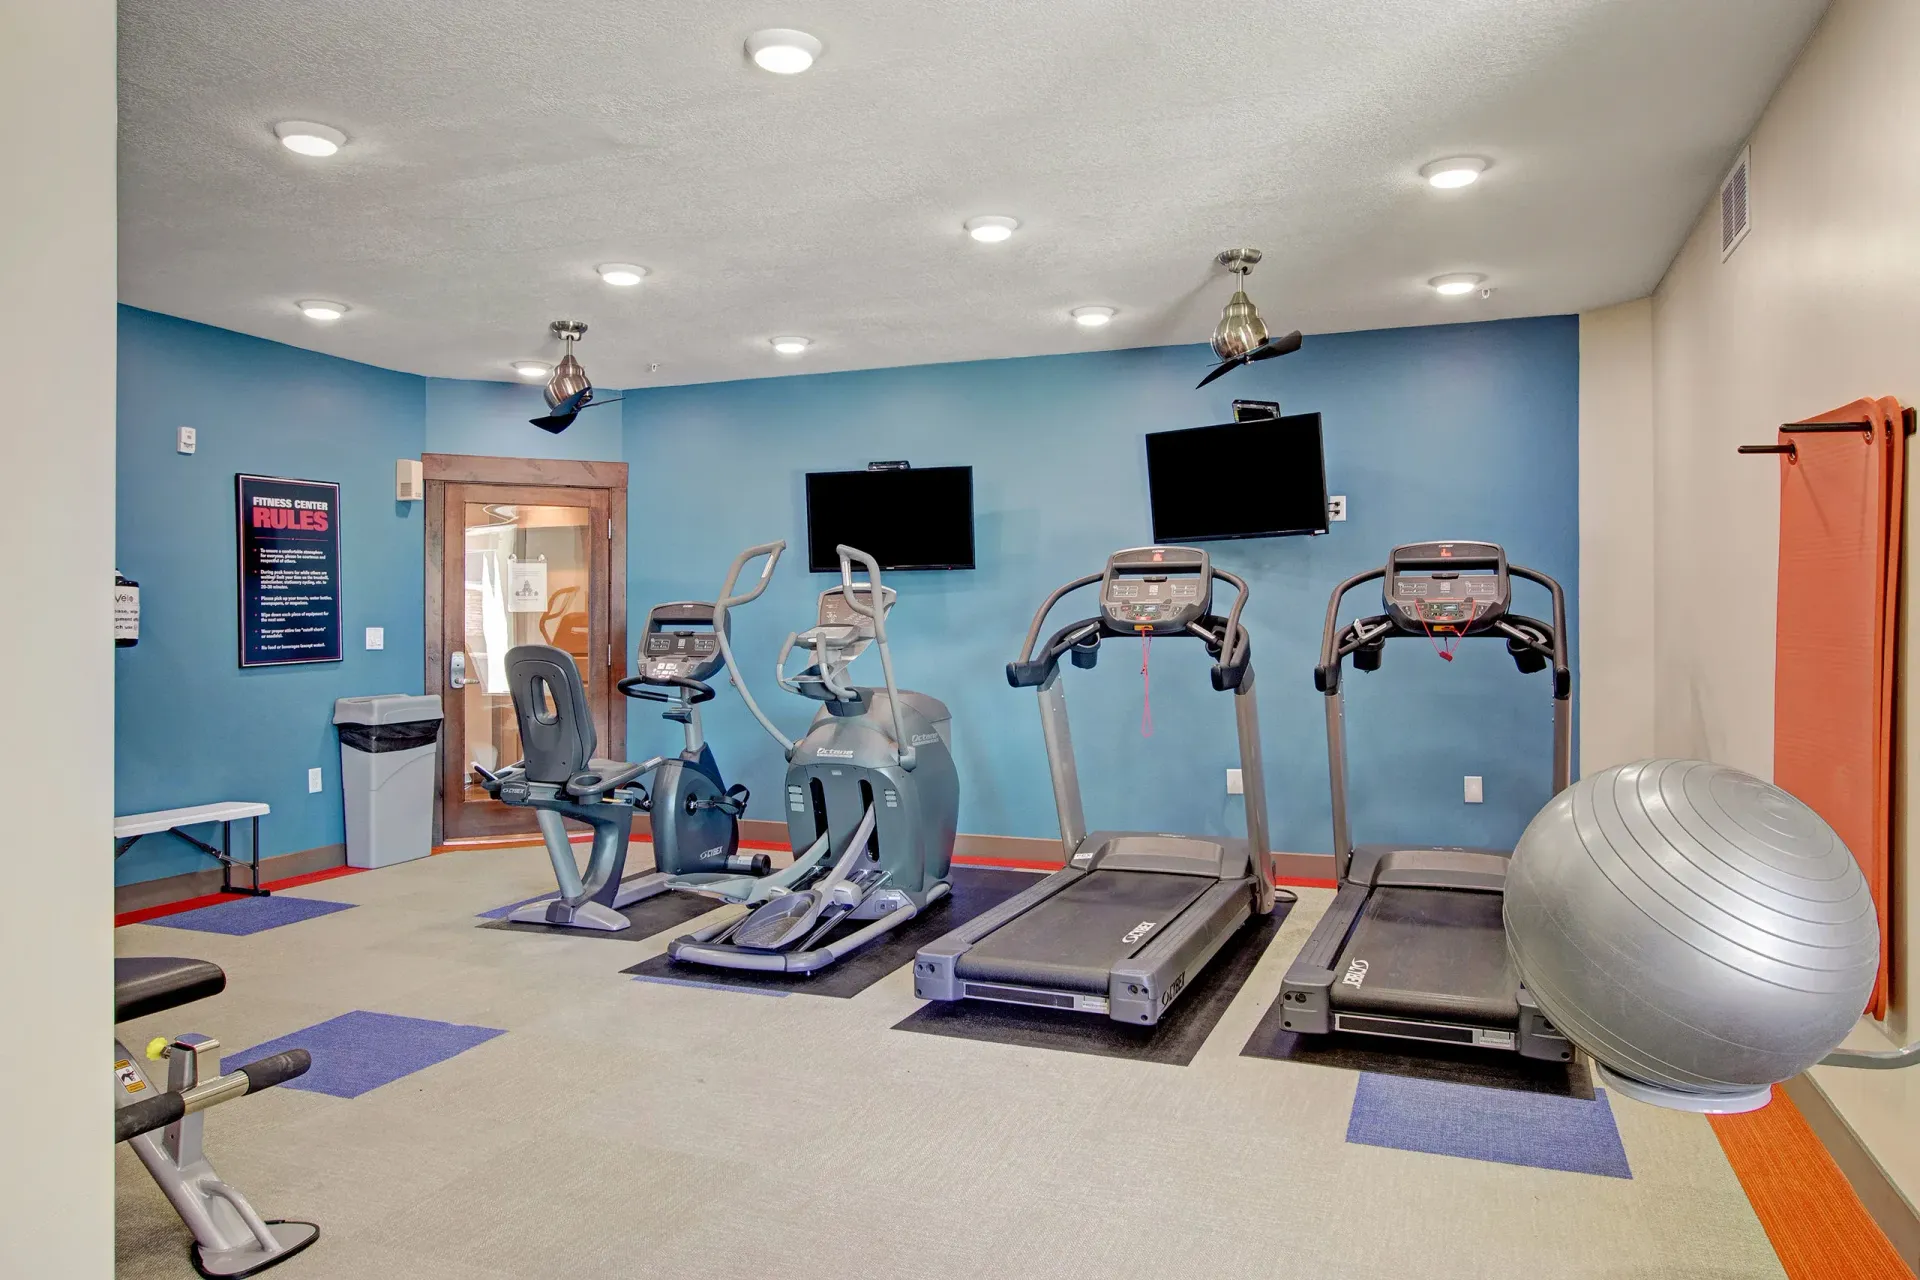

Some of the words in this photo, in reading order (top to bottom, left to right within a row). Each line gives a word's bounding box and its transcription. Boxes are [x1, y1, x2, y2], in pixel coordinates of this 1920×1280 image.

[253, 496, 292, 508] FITNESS
[294, 500, 328, 511] CENTER
[253, 507, 328, 531] RULES
